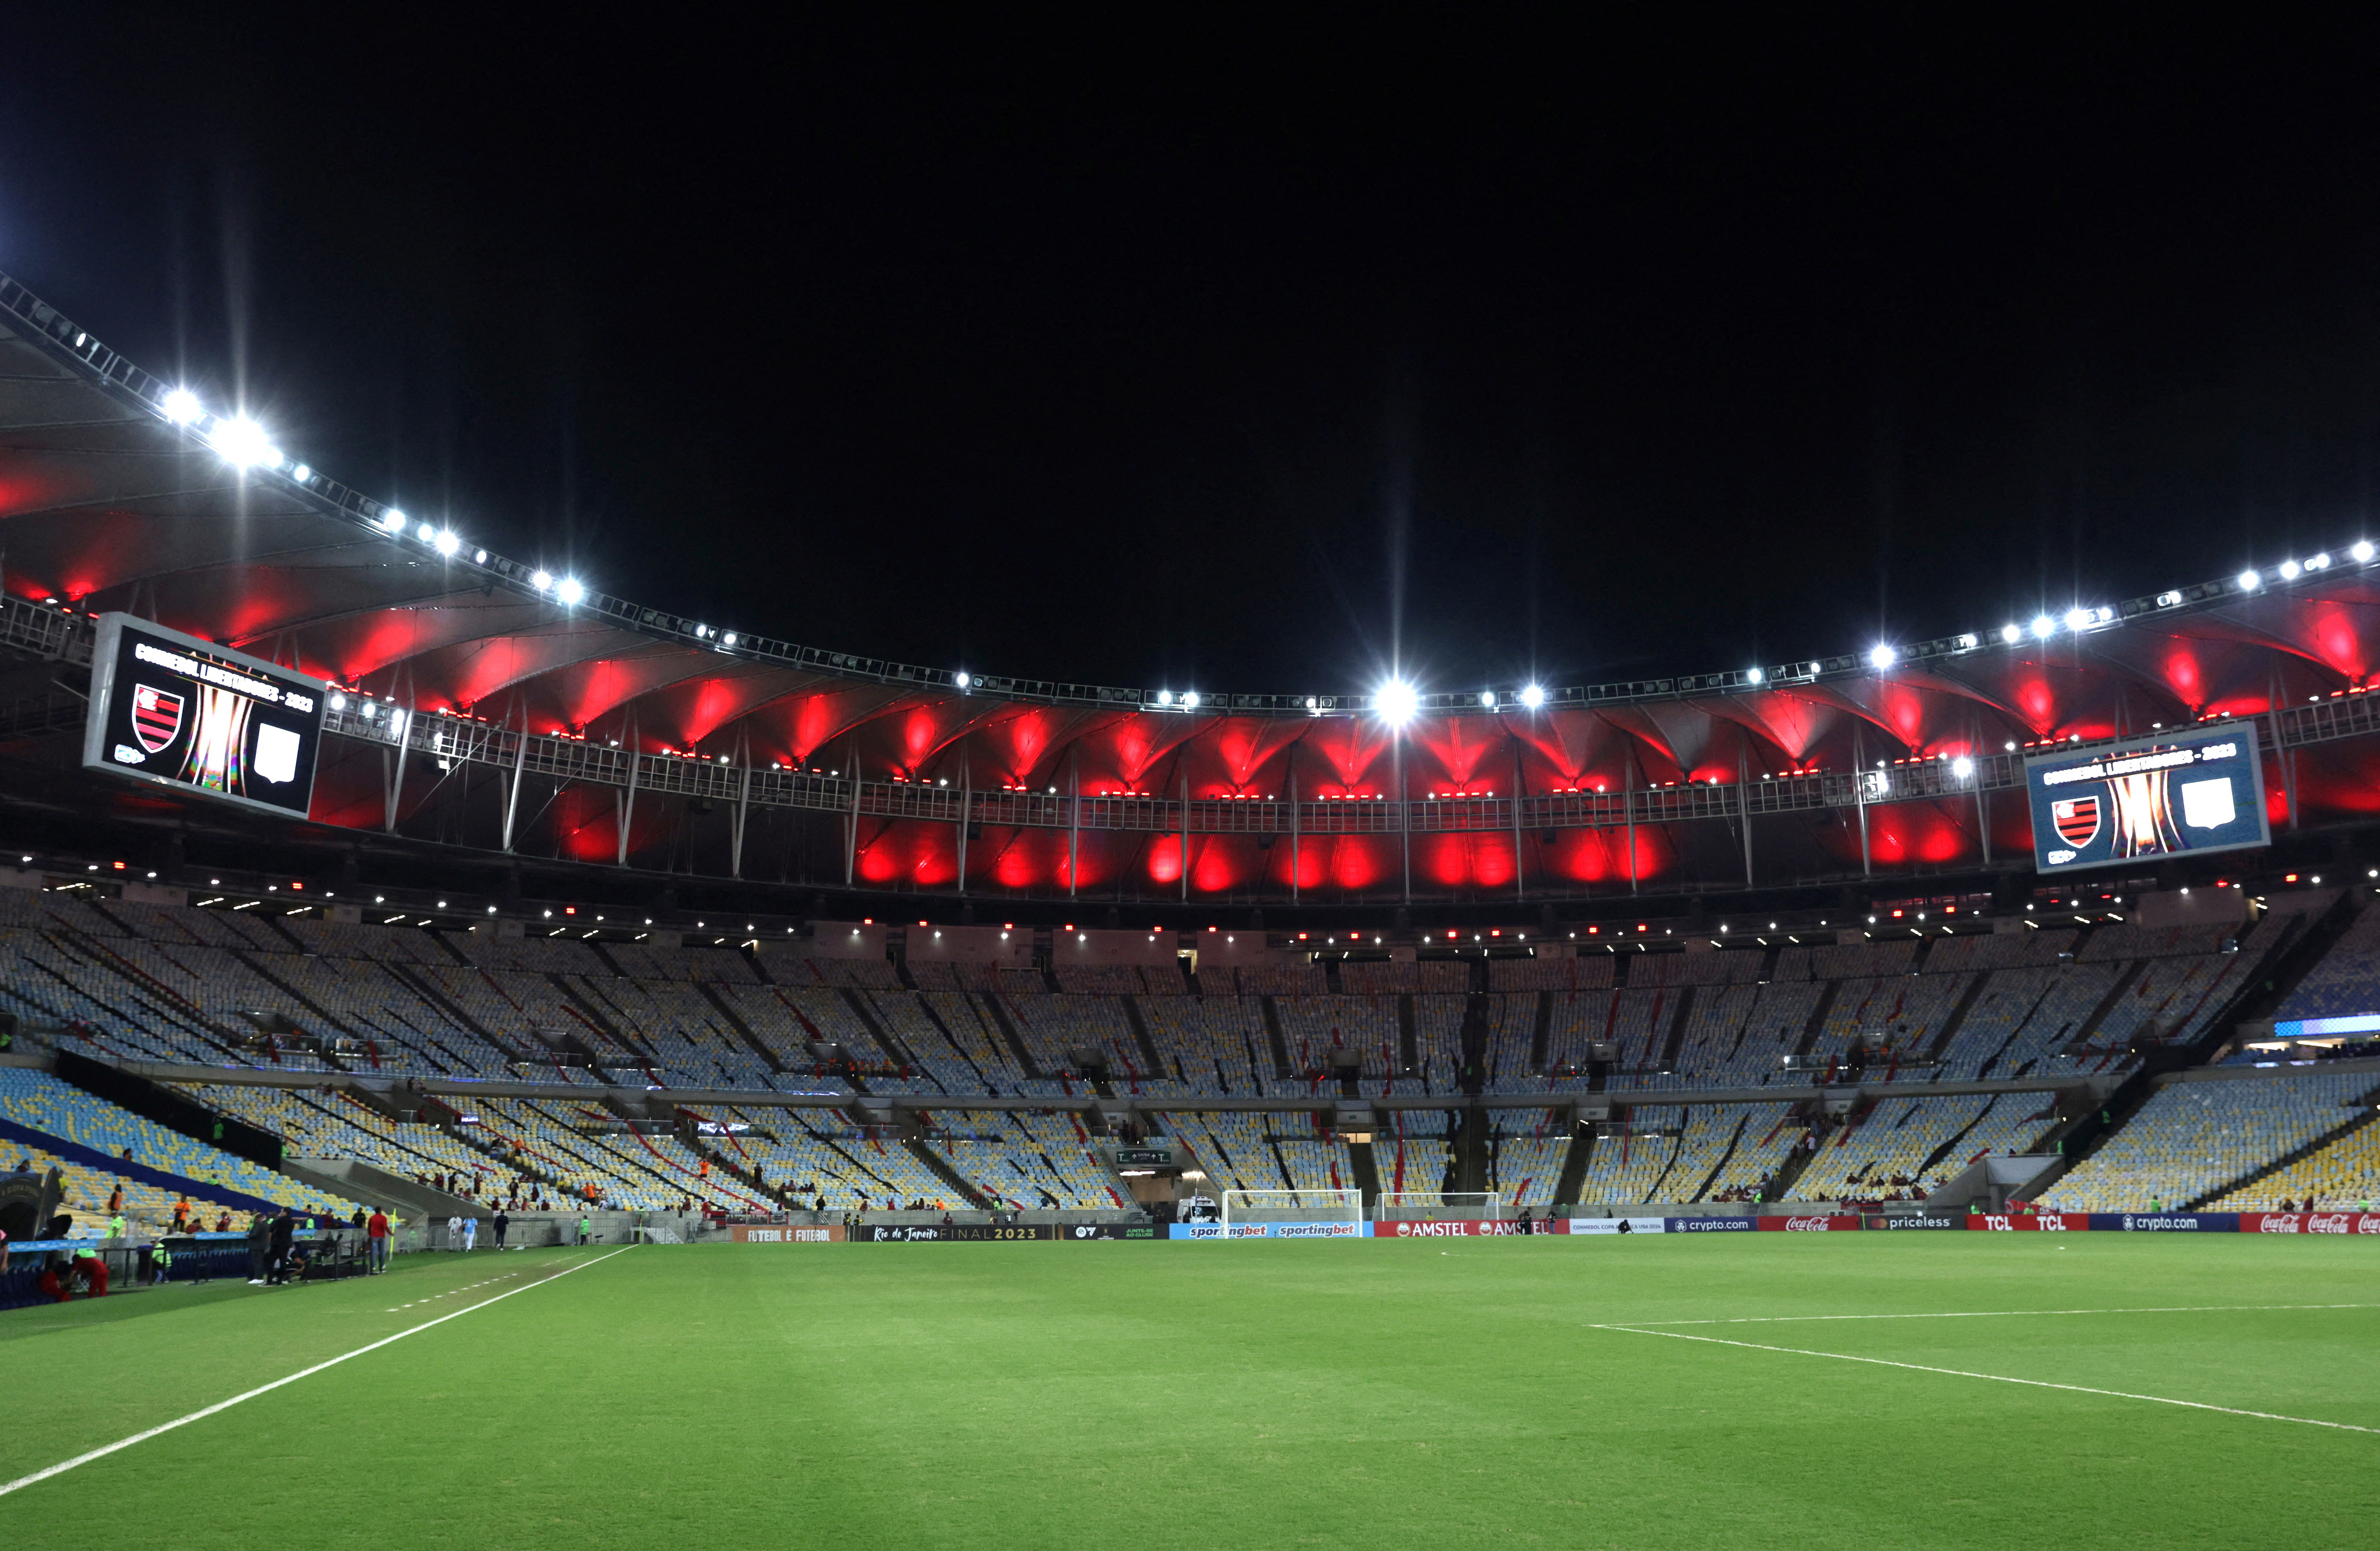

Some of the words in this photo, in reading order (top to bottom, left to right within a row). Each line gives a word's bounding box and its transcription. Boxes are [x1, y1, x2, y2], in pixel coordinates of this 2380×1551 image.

[1118, 1153, 1124, 1162] T
[1158, 1154, 1164, 1162] T
[1412, 1222, 1468, 1236] AMSTEL
[1494, 1222, 1549, 1235] AMSEL
[1689, 1221, 1748, 1231] crypto.com
[1786, 1217, 1830, 1231] Coca-Cola
[1890, 1217, 1950, 1230] priceless
[1985, 1216, 2013, 1231] TCL
[2037, 1215, 2066, 1231] TCL
[2136, 1217, 2198, 1230] crypto.com
[2261, 1214, 2300, 1233] Coca-Cola
[2308, 1214, 2349, 1233] Coca-Cola
[748, 1230, 781, 1242] FUTEBOL
[786, 1228, 792, 1242] É
[796, 1230, 830, 1241] FUTEBOL
[874, 1226, 888, 1242] Rio
[892, 1227, 902, 1238] de
[904, 1227, 937, 1242] Janeiro
[940, 1229, 991, 1239] FINAL
[994, 1228, 1036, 1239] 2023
[1190, 1224, 1266, 1238] sportngbet
[1279, 1224, 1354, 1237] sportingbet
